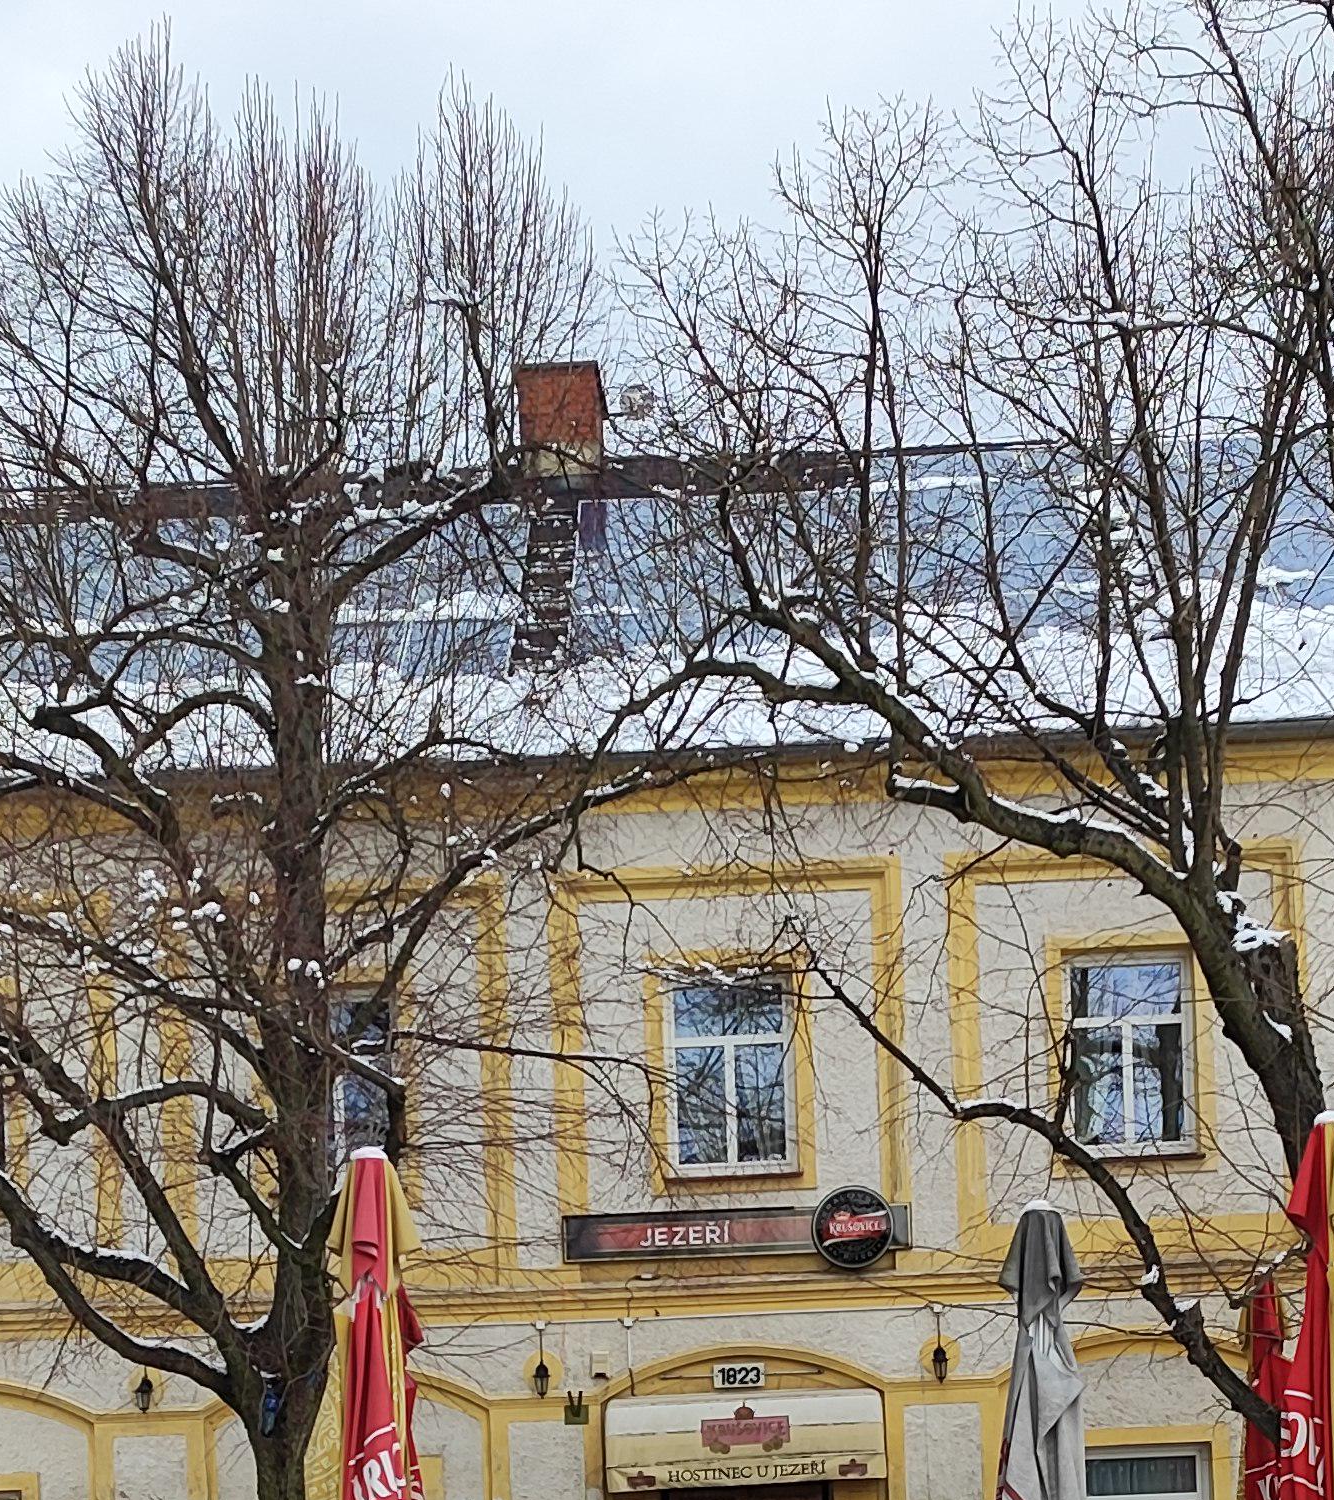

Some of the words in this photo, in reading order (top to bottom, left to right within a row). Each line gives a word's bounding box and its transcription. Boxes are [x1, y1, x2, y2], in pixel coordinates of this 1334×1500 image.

[639, 1219, 730, 1247] JEZEŘÍ
[717, 1366, 761, 1386] 1823
[667, 1465, 753, 1483] HOSTINEC
[756, 1464, 769, 1478] U
[771, 1459, 827, 1480] JEZEŘÍ
